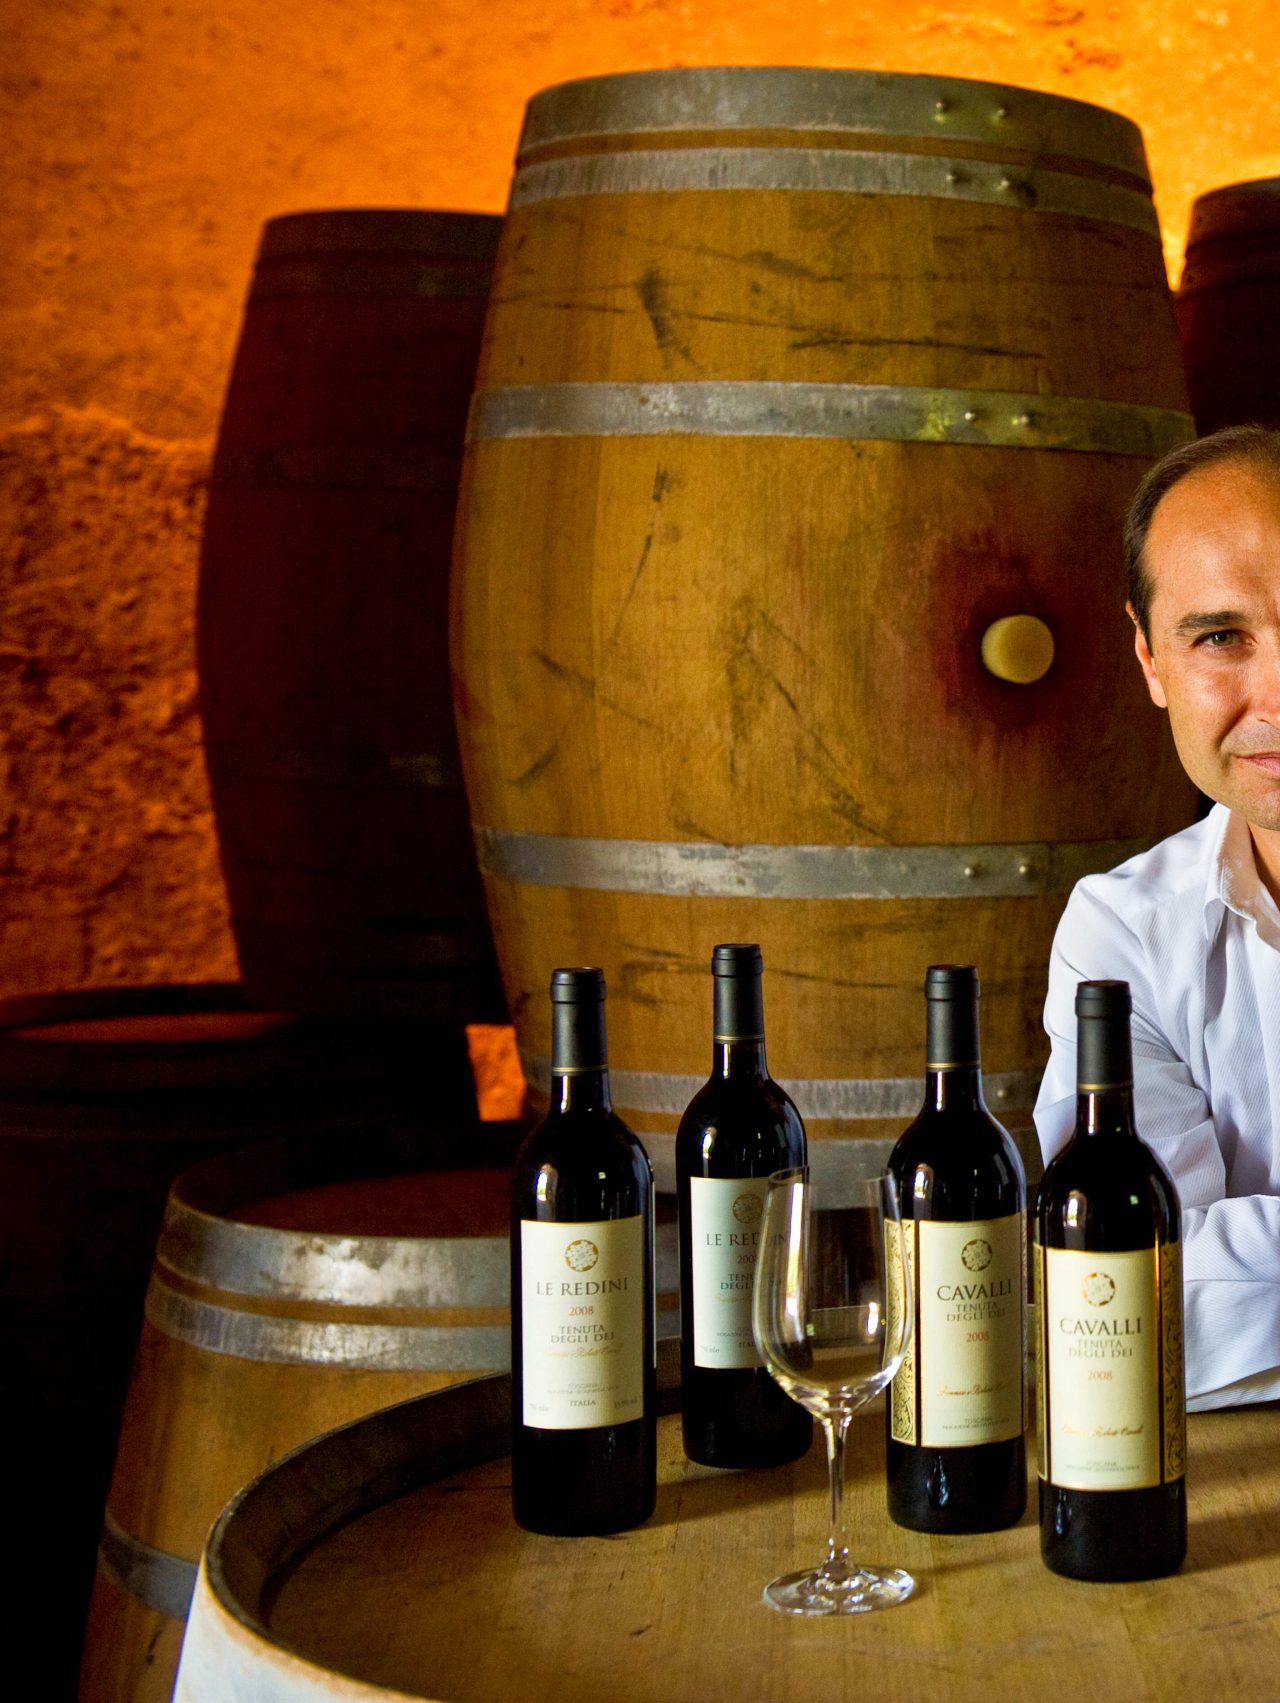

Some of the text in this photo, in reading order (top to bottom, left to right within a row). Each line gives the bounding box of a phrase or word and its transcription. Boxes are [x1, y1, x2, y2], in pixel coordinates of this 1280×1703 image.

[705, 1232, 722, 1246] LE
[536, 1277, 628, 1296] LE REDINI
[937, 1279, 1011, 1301] CAVALLI
[569, 1306, 594, 1316] 2008
[956, 1302, 998, 1312] TENUTA
[946, 1308, 1005, 1321] DEGLI DEI
[560, 1324, 605, 1334] TENUTA
[1060, 1317, 1142, 1336] CAVALLI
[550, 1332, 614, 1343] DEGLI DEI
[1077, 1338, 1123, 1349] TENUTA
[1068, 1348, 1133, 1358] DEGLI DEI
[1087, 1371, 1113, 1381] 2008
